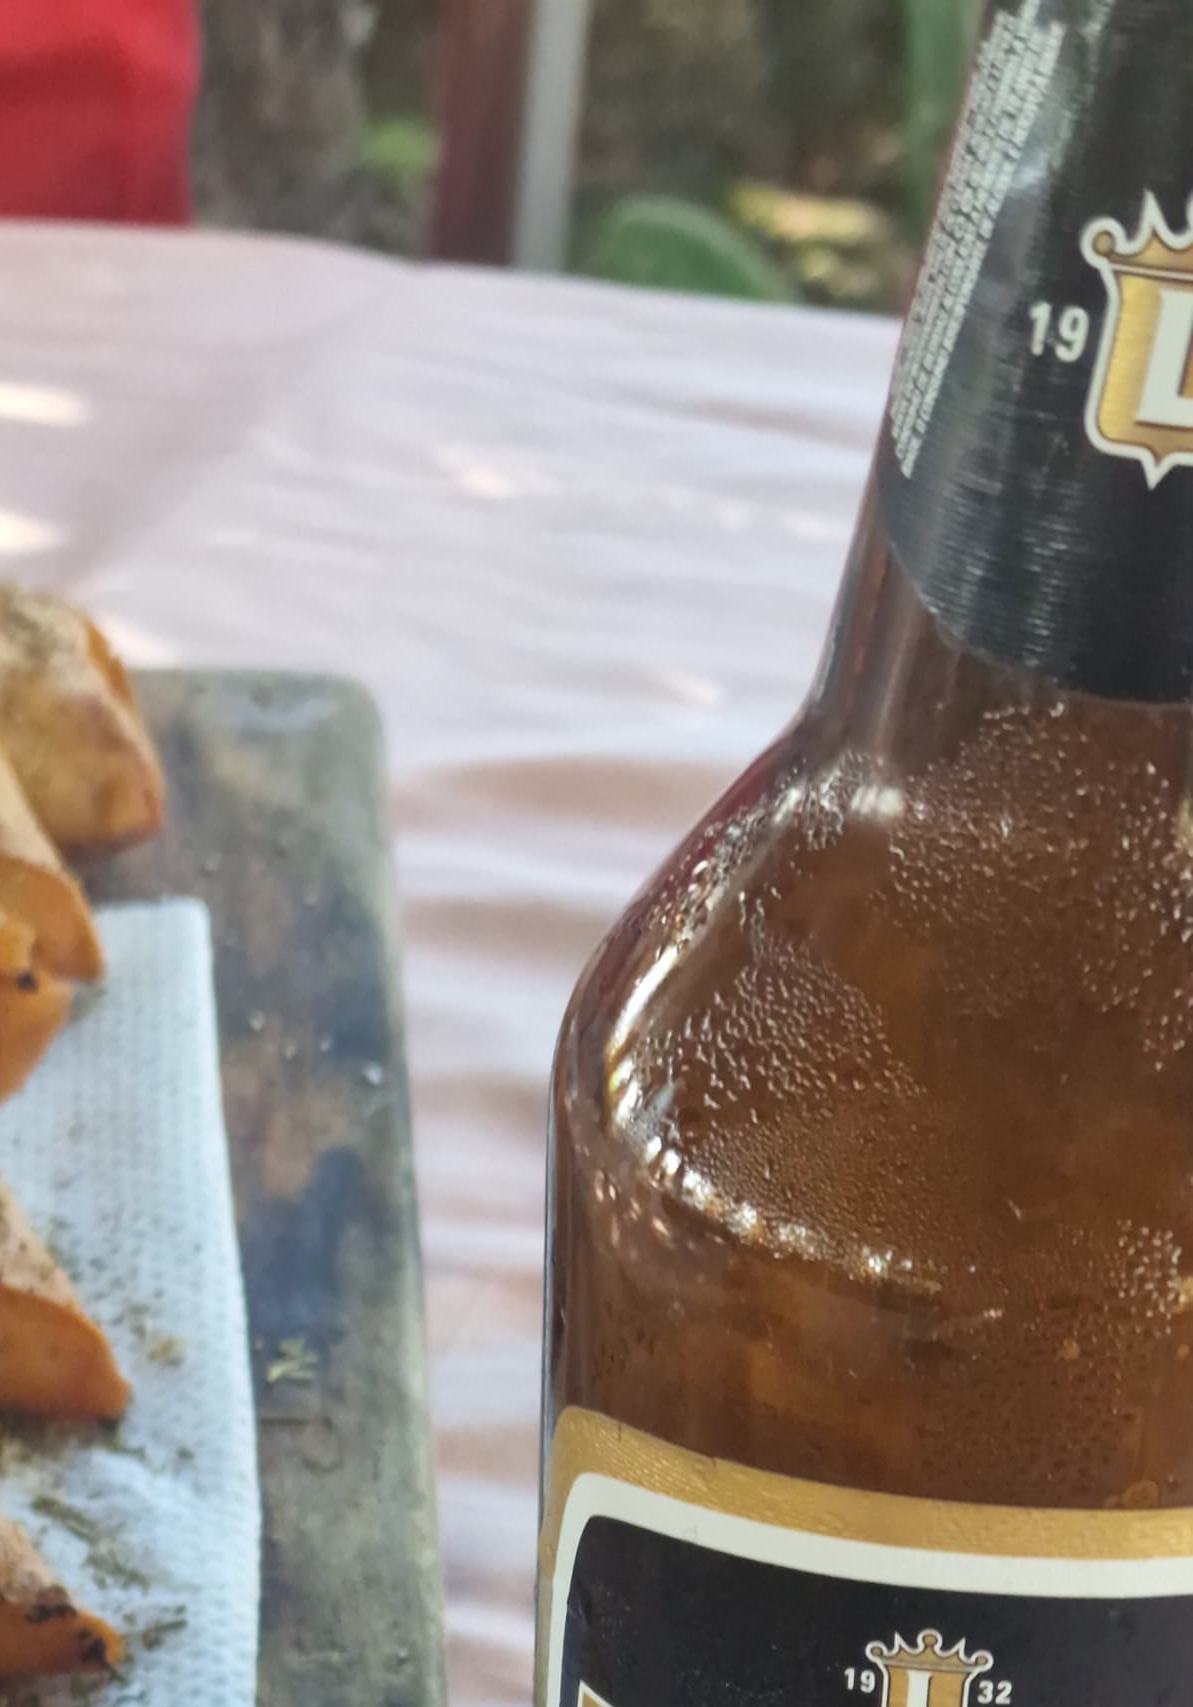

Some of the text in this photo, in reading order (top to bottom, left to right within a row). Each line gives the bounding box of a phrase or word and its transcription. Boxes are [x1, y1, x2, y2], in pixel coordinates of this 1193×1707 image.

[1029, 302, 1090, 363] 19
[844, 1667, 876, 1694] 19
[977, 1679, 1013, 1705] 32
